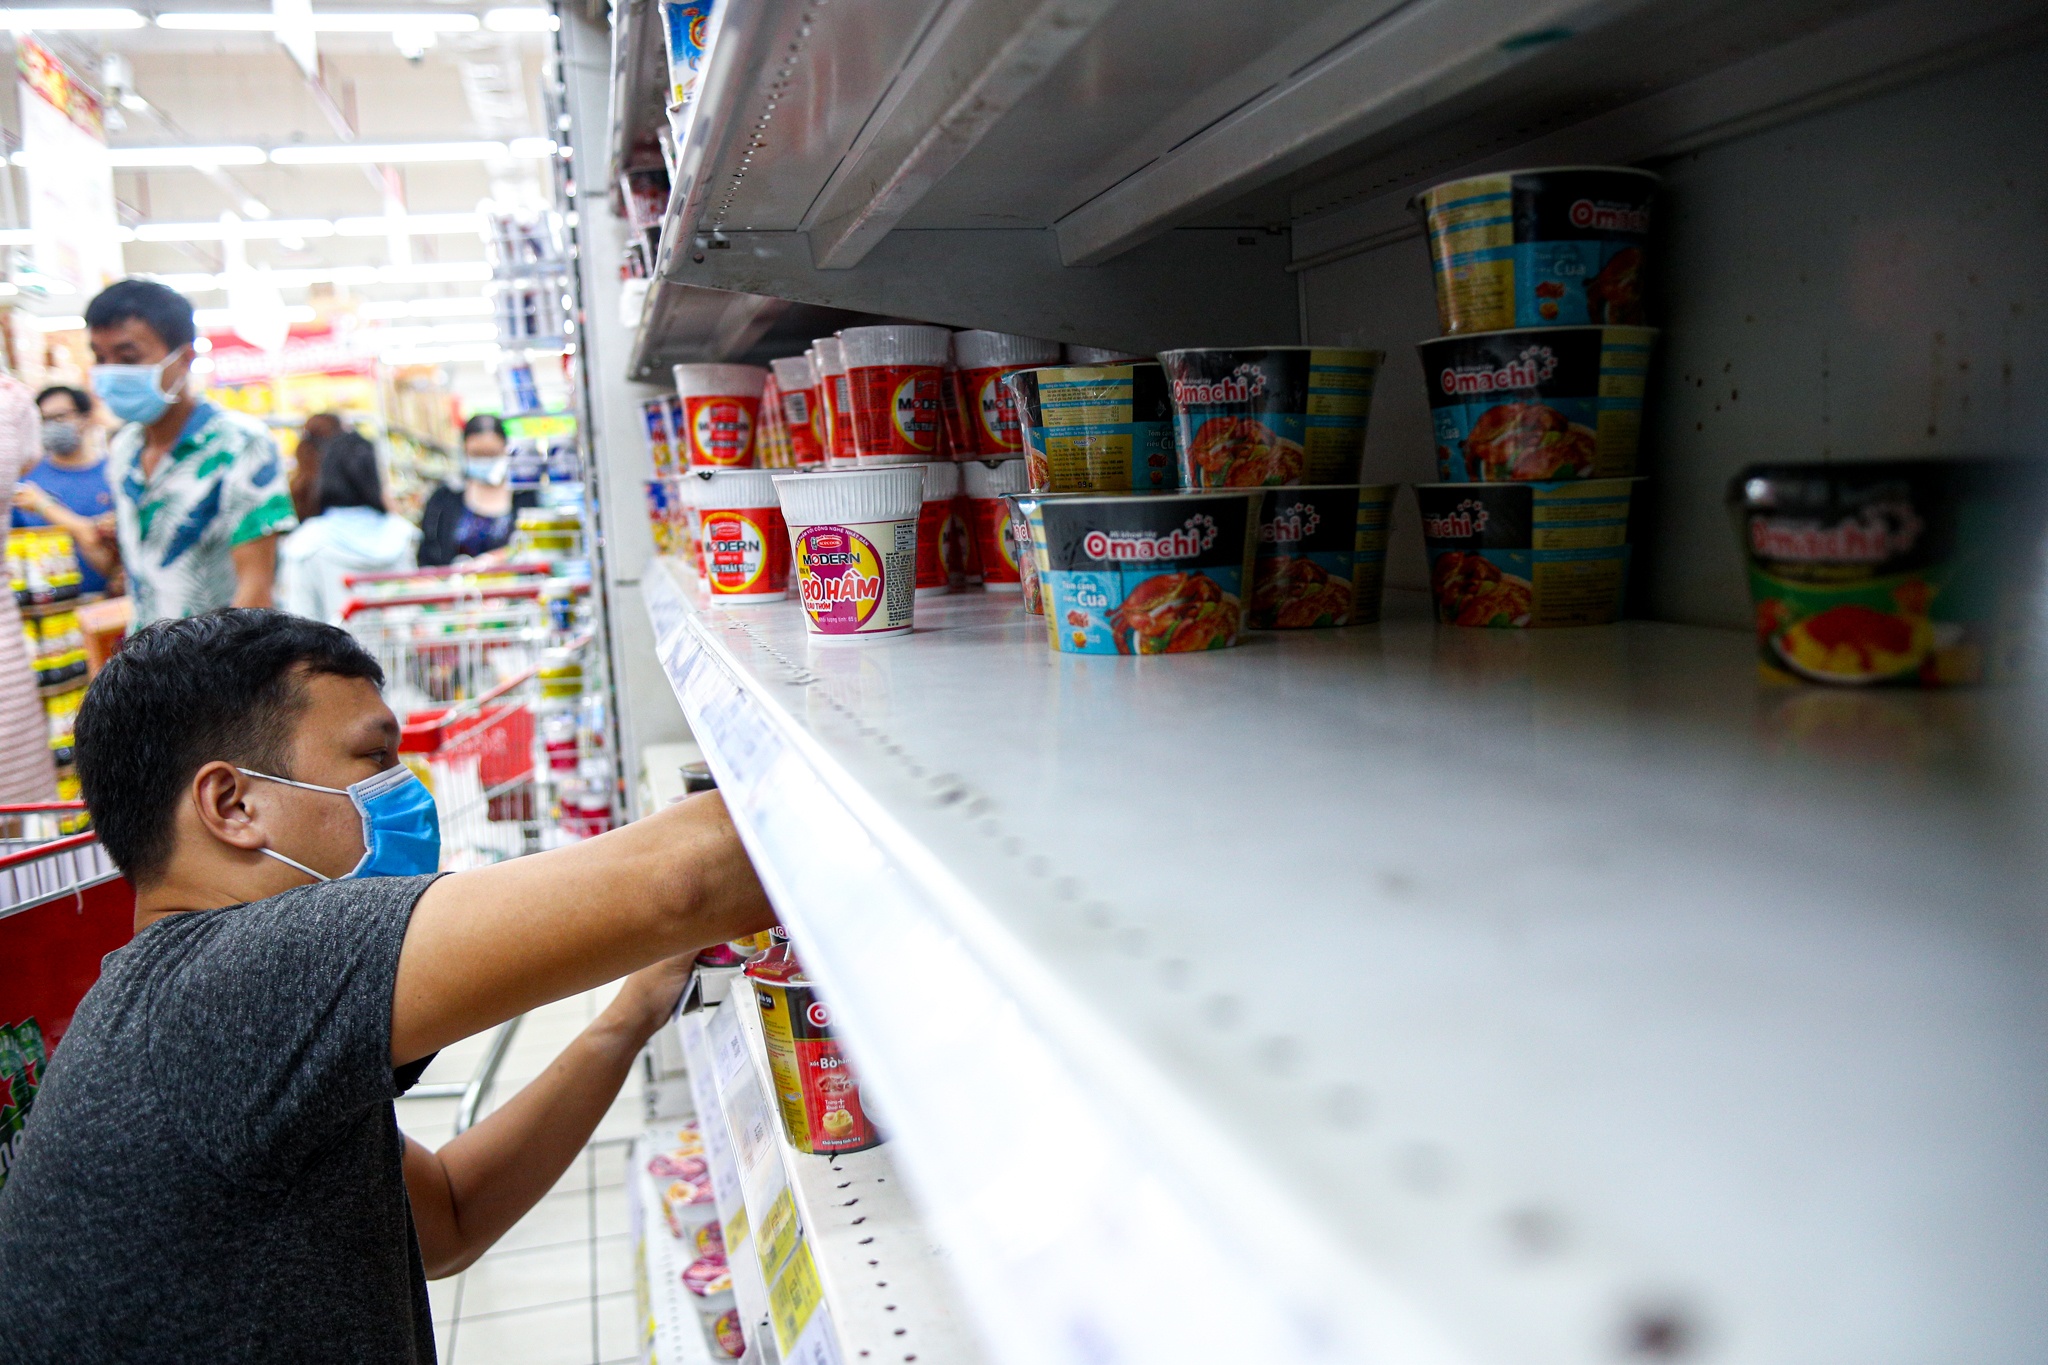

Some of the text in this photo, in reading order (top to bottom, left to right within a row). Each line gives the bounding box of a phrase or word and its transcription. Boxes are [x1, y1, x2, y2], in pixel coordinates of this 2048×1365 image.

[1440, 359, 1538, 395] Omachi
[1174, 376, 1248, 405] Omachi
[1160, 437, 1174, 450] Cu
[1084, 528, 1201, 561] Omachi
[802, 553, 861, 566] MODERN
[801, 573, 822, 601] BÒ
[826, 569, 880, 601] HẦM
[1077, 590, 1107, 607] Cua
[820, 1057, 838, 1069] Bò
